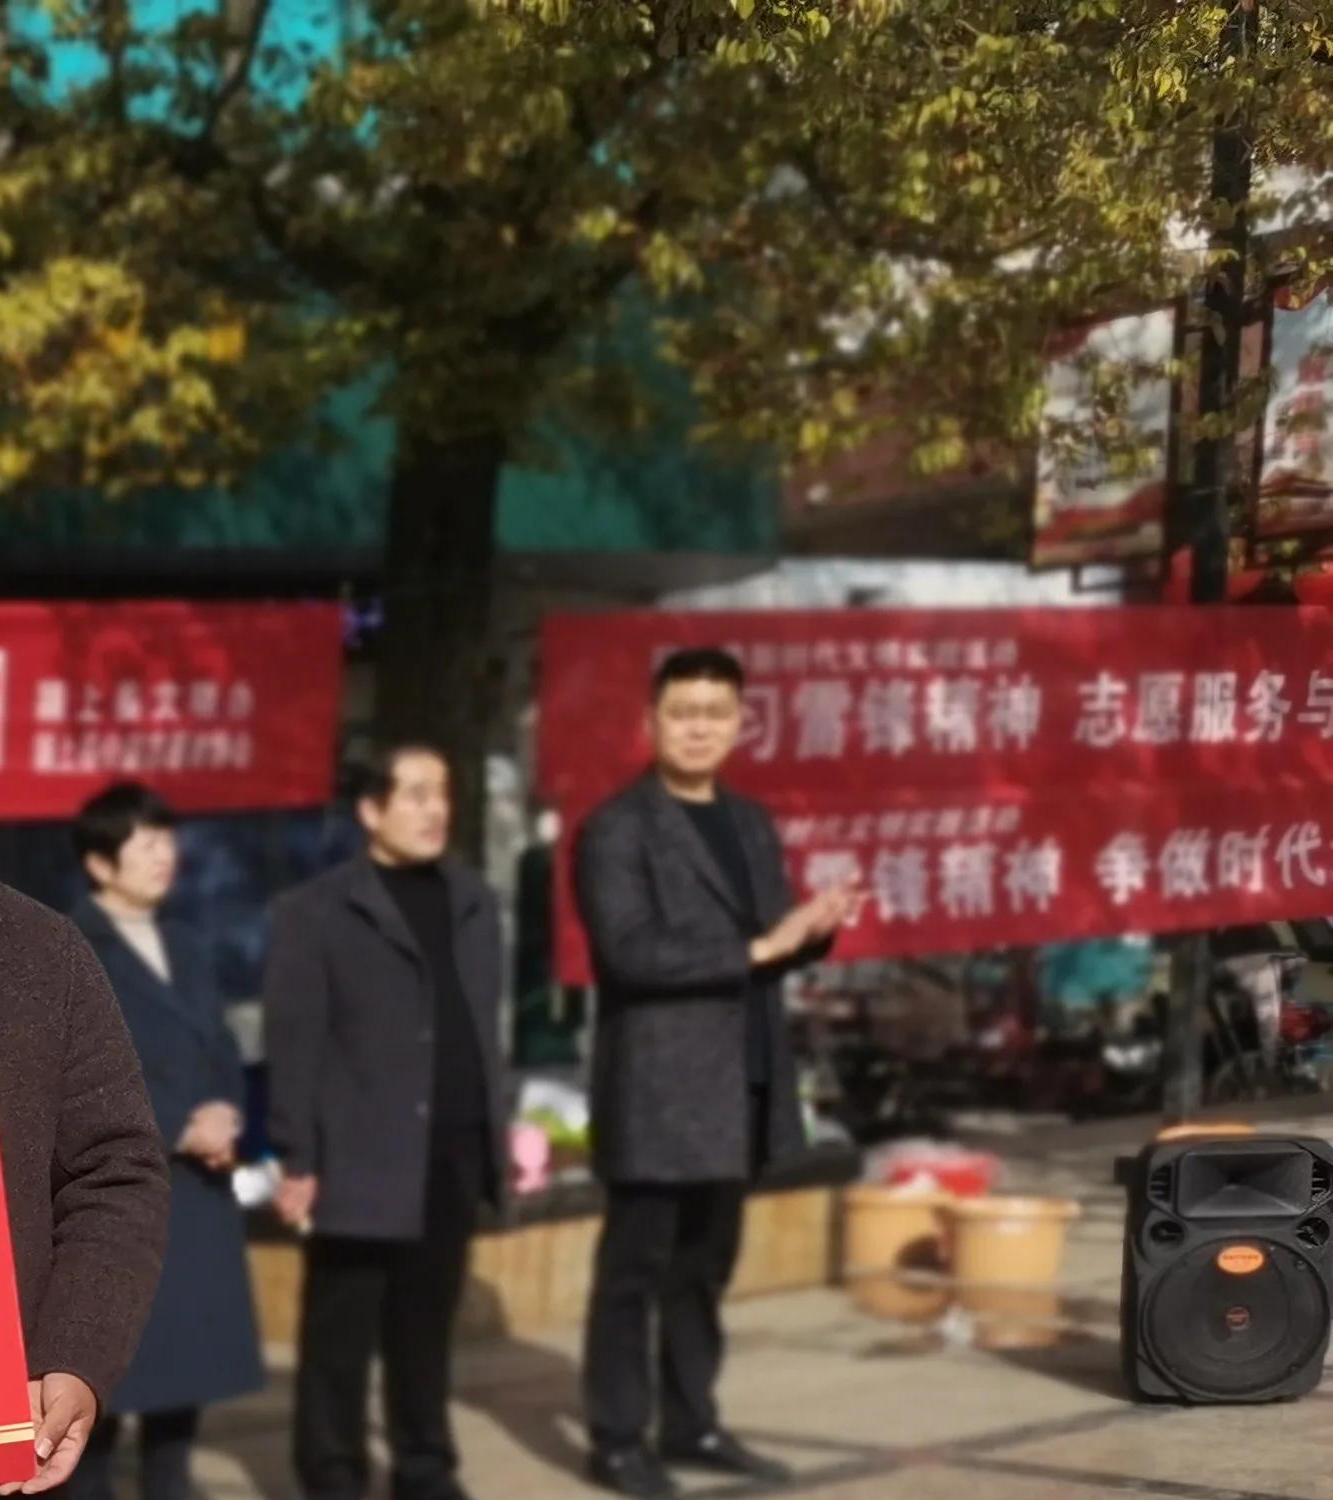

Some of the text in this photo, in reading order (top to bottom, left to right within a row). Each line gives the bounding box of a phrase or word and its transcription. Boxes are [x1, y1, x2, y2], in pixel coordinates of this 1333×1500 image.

[788, 822, 1333, 926] 雷锋精神 争做时代
